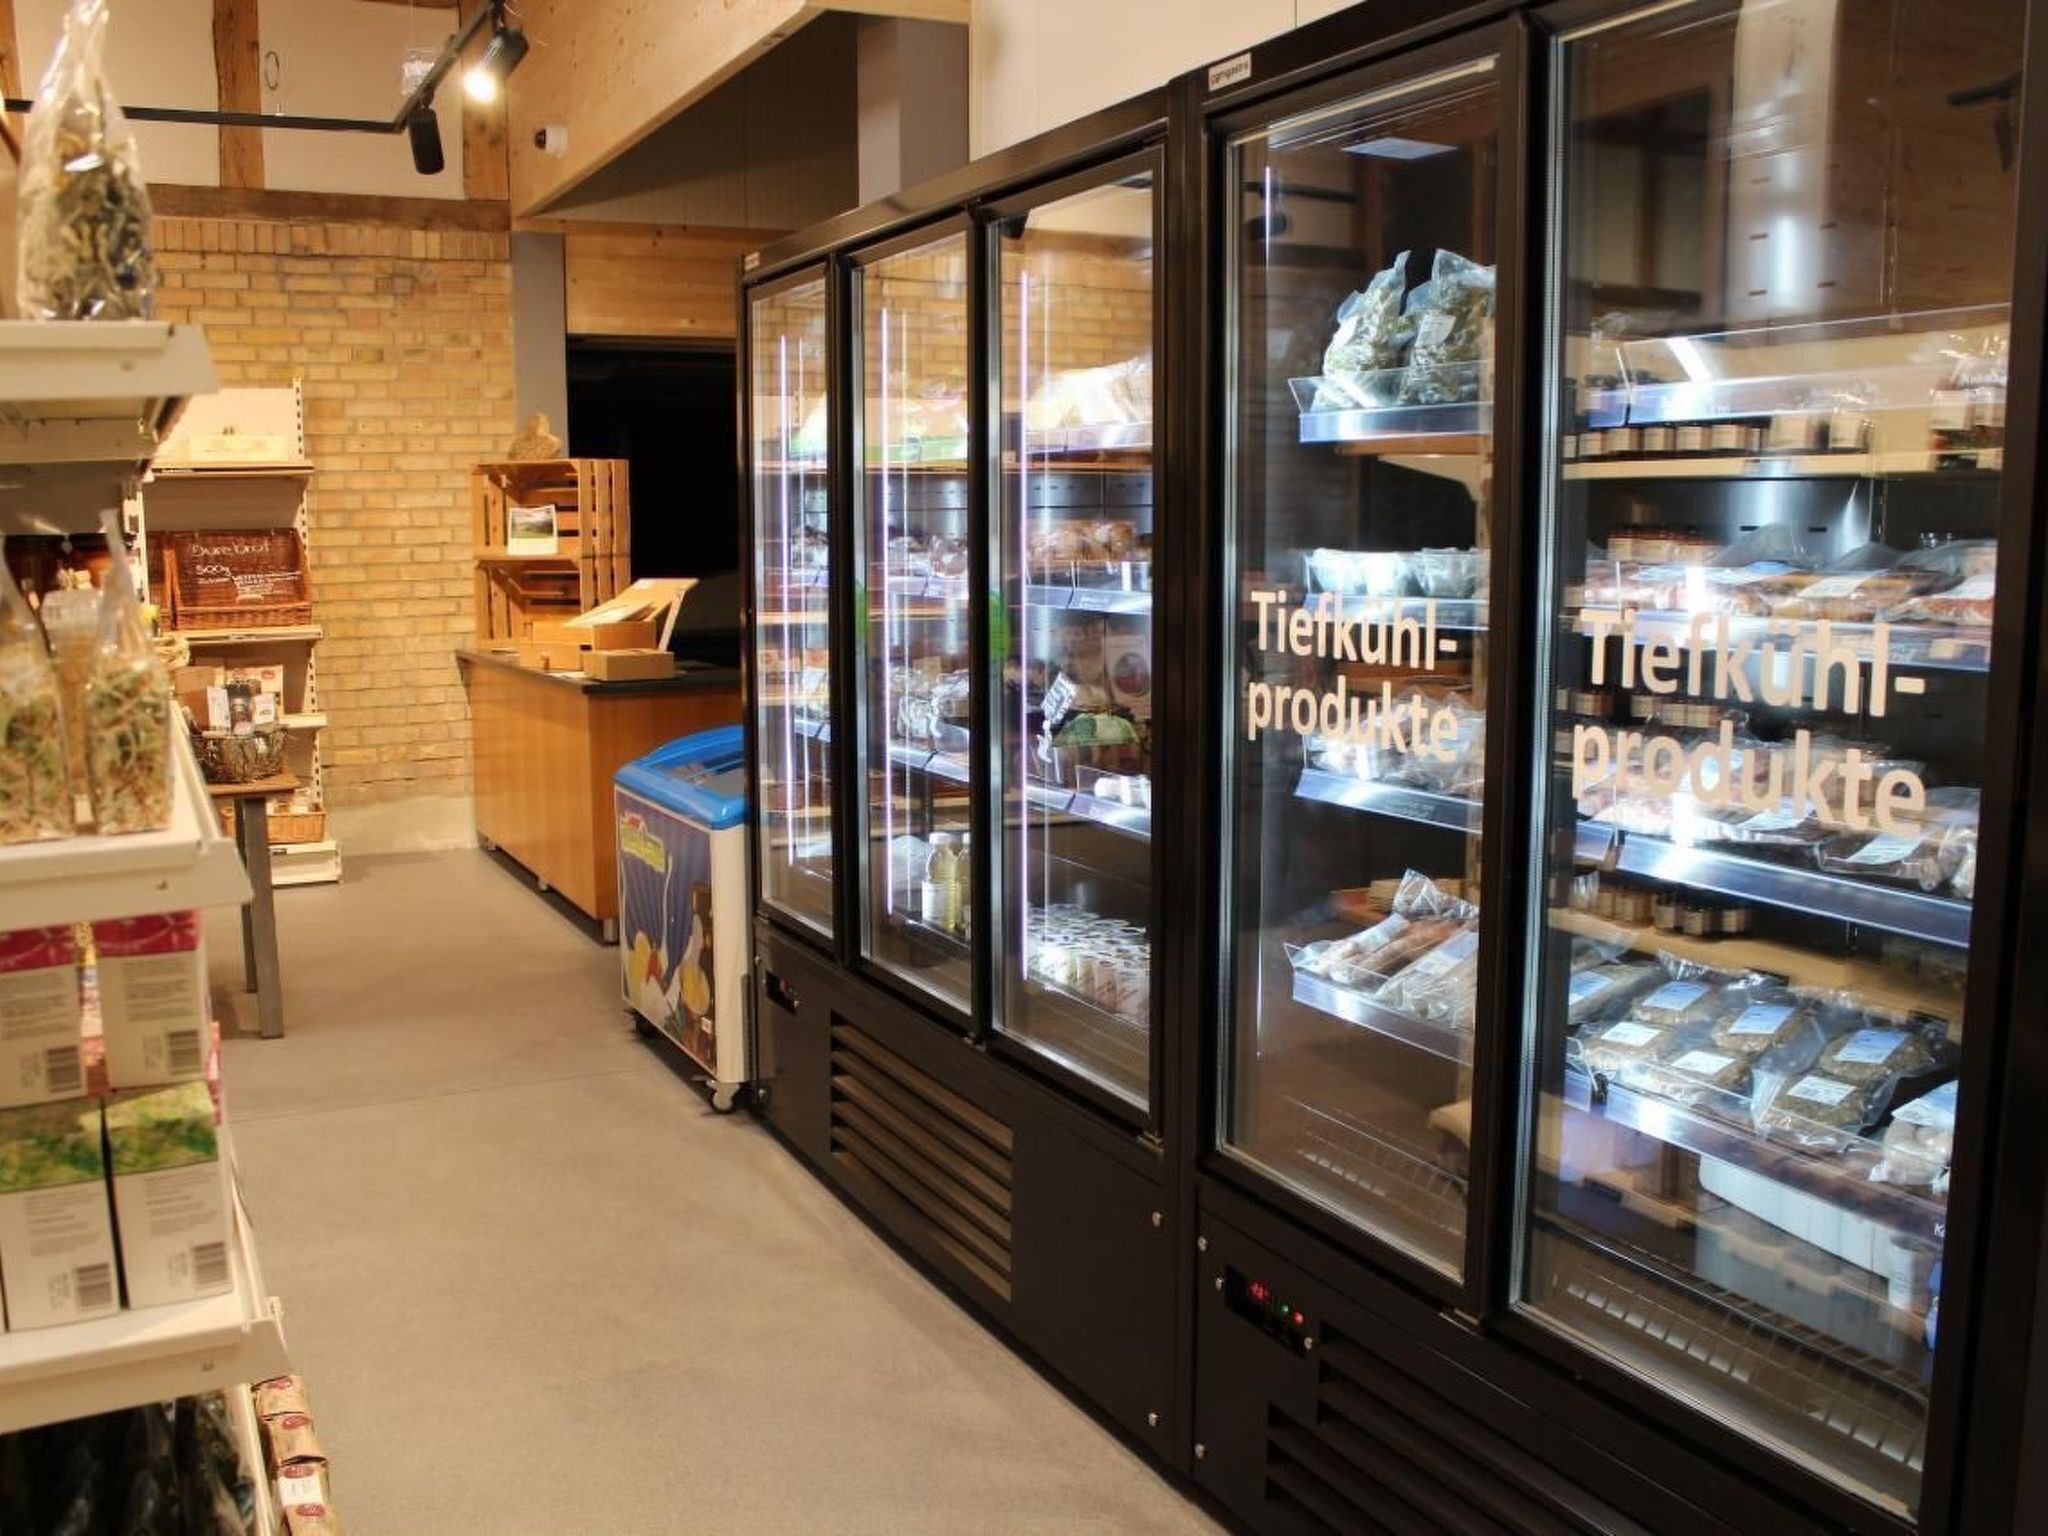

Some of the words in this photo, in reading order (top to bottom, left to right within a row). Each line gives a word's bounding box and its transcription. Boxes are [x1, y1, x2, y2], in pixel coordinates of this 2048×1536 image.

[1251, 590, 1458, 670] Tiefkühl-
[1579, 607, 1926, 717] Tiefkühl-
[1247, 675, 1459, 762] produkte
[1572, 720, 1926, 839] produkte
